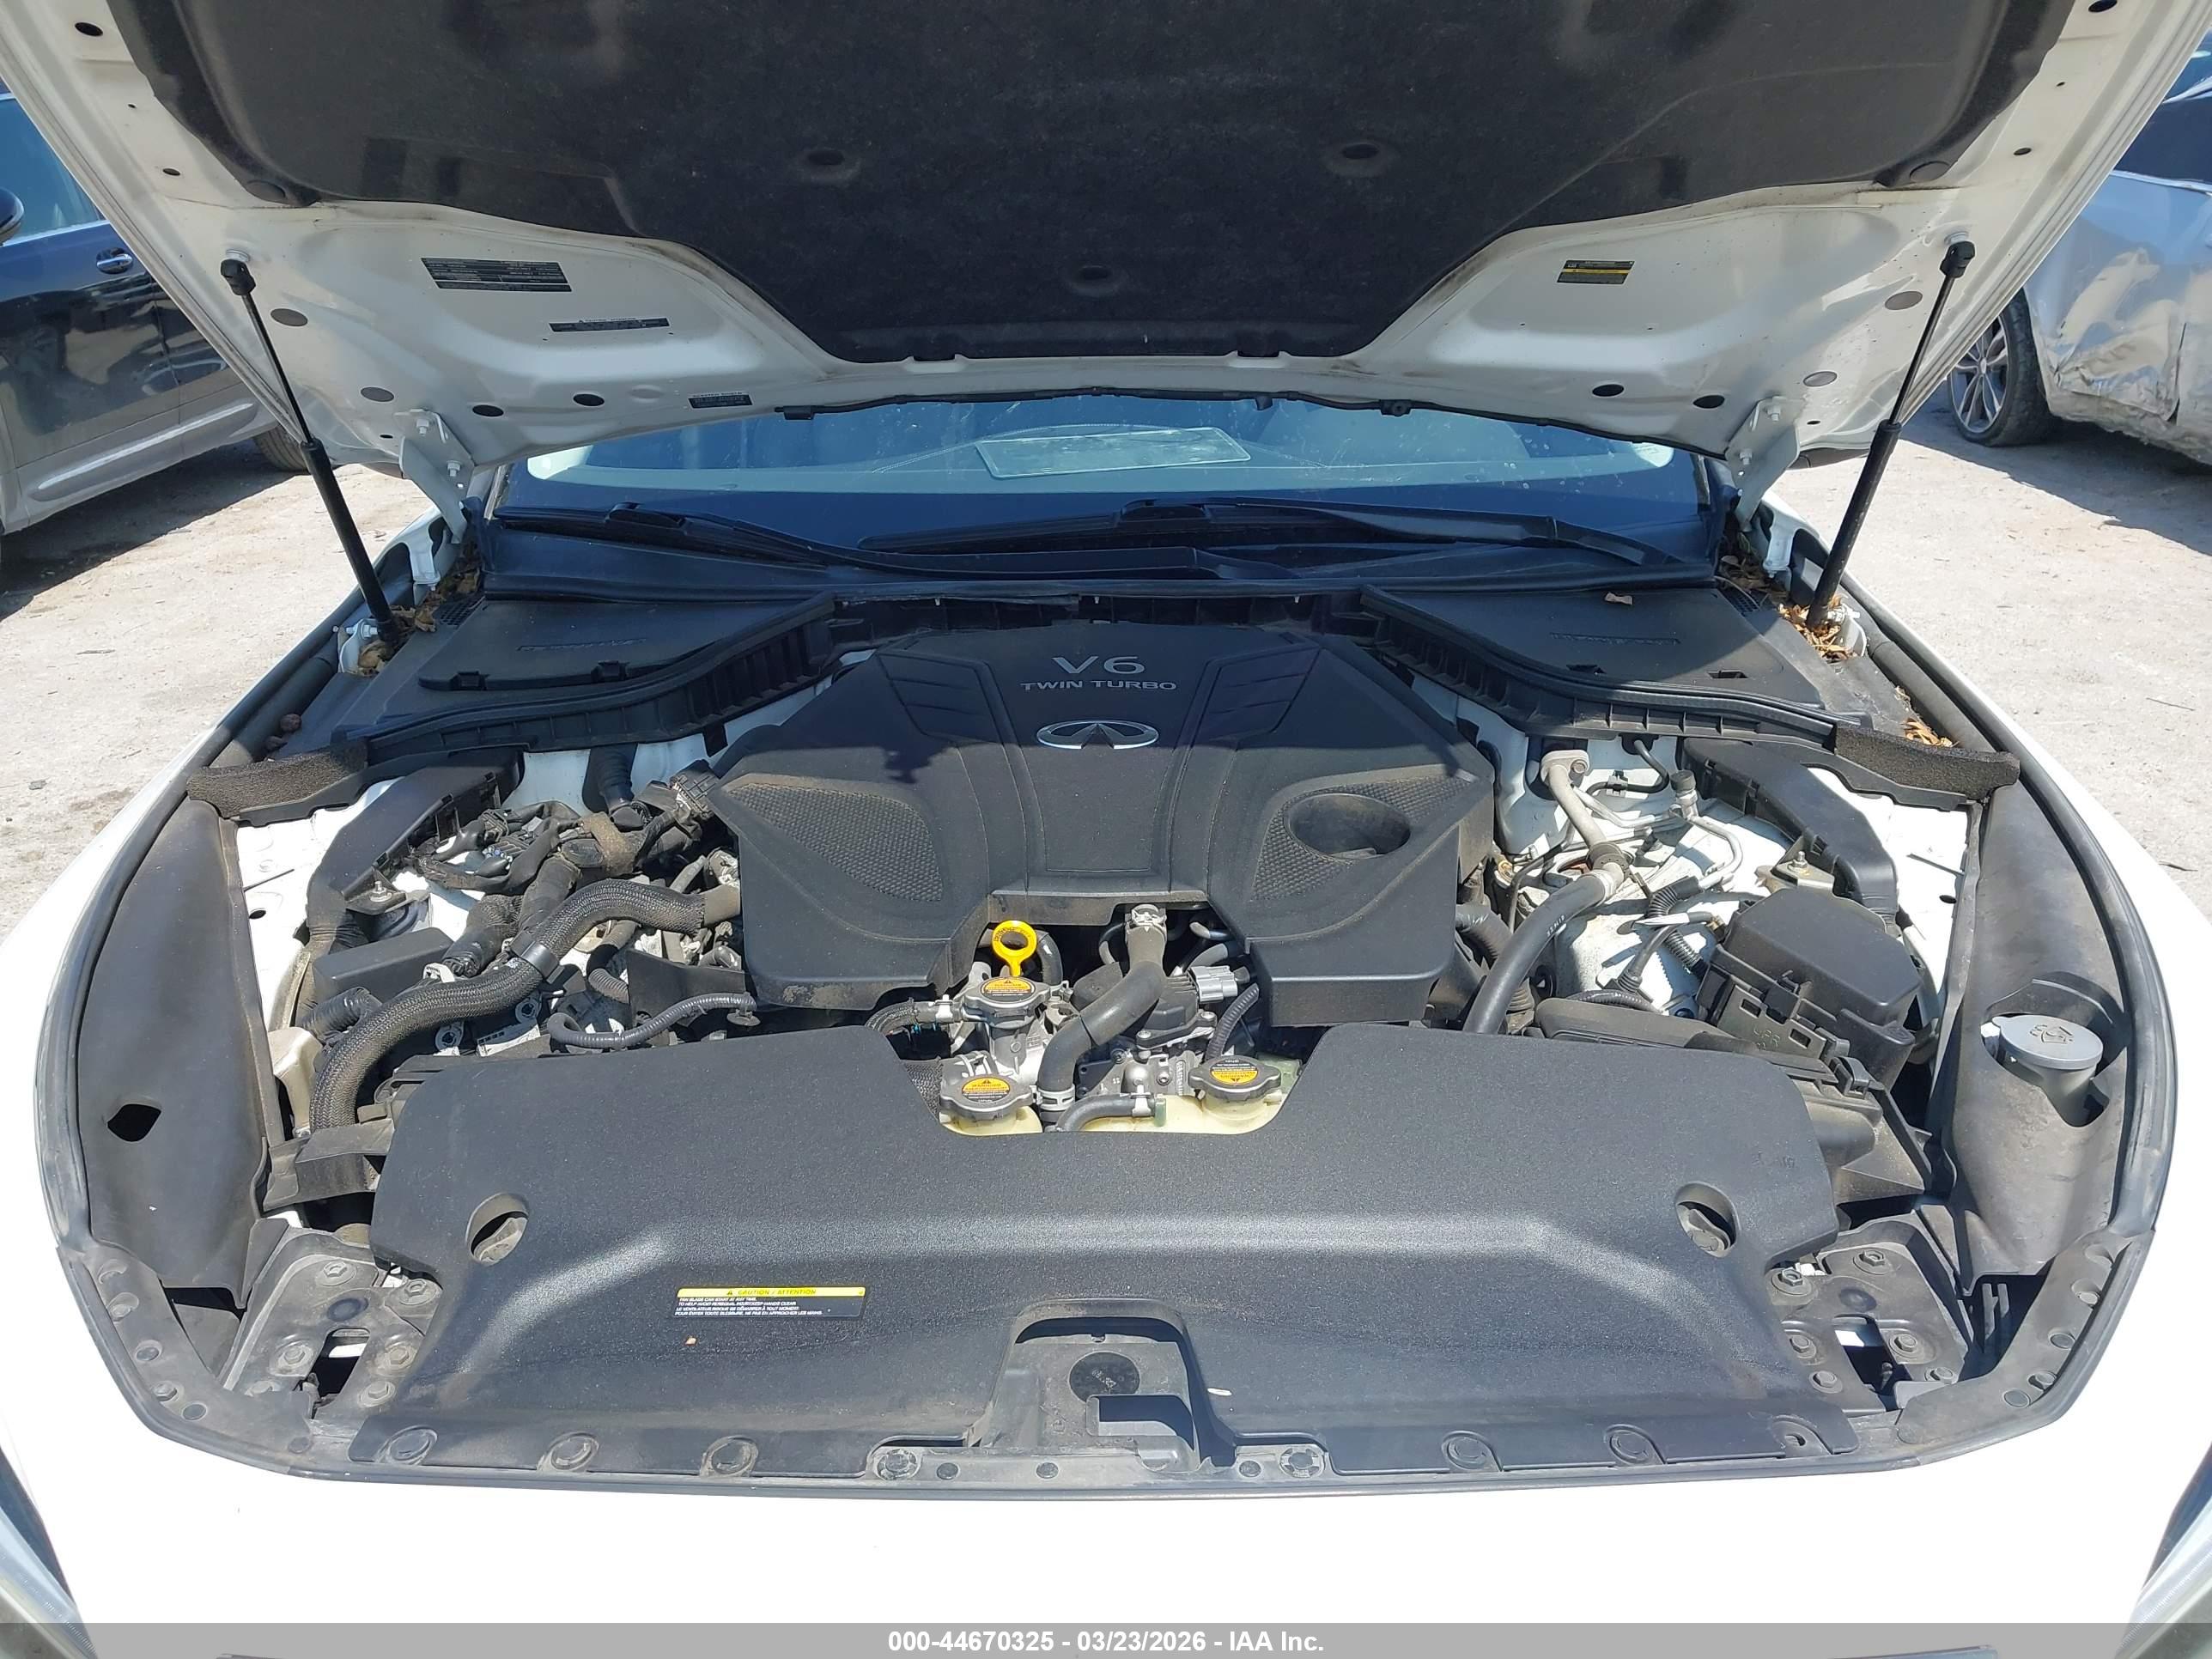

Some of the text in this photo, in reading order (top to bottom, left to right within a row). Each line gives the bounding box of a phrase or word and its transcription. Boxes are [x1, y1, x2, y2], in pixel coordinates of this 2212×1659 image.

[1051, 655, 1146, 675] V6
[1020, 680, 1176, 691] TWIN TURBO
